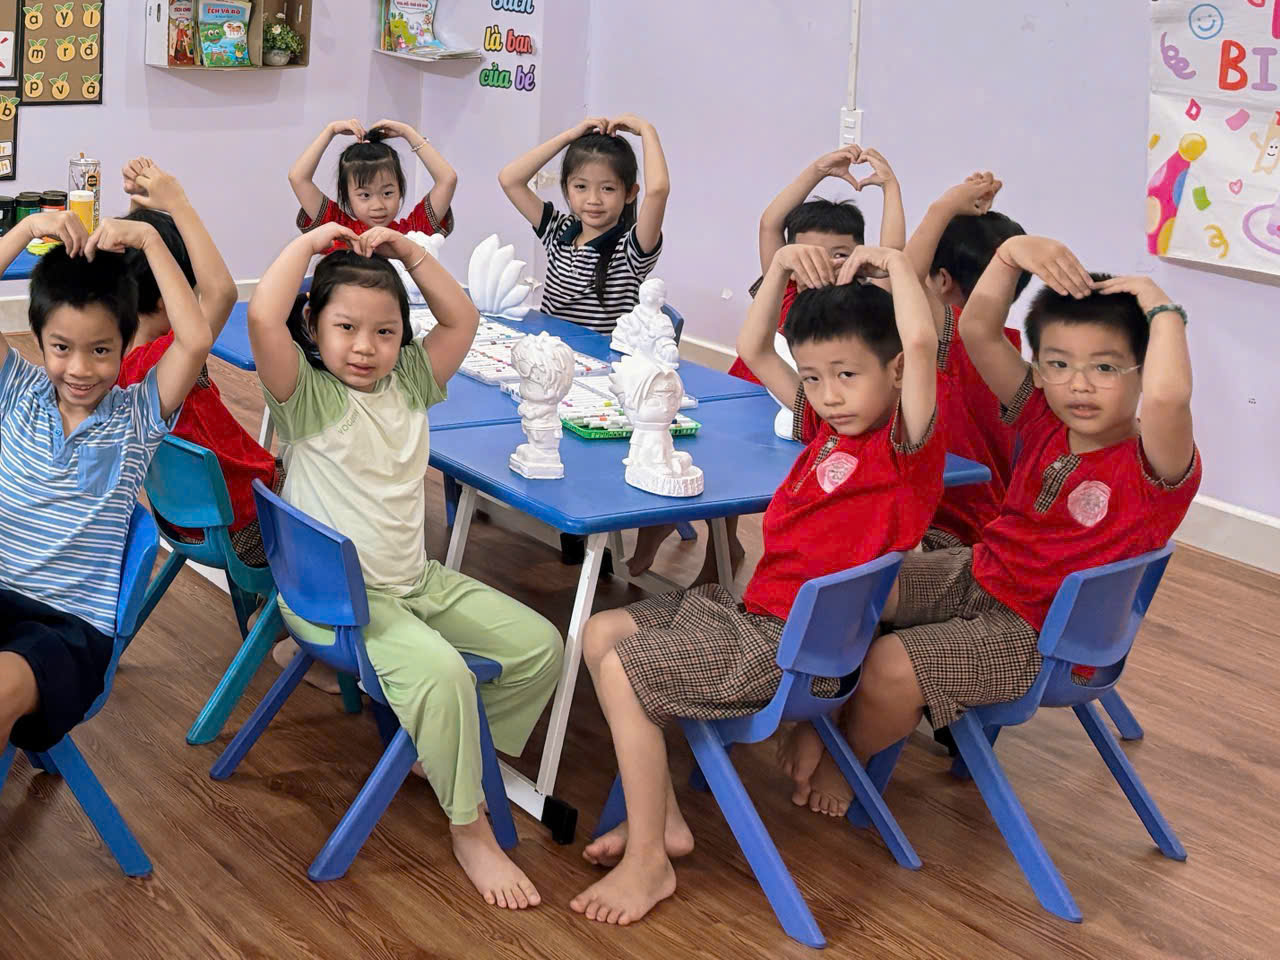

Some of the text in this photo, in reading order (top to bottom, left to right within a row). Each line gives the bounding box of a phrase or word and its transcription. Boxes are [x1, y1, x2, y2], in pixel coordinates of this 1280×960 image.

[29, 15, 38, 24] a
[60, 11, 69, 25] y
[483, 24, 533, 56] là bạn
[31, 43, 93, 59] m r đ
[479, 62, 536, 92] của bé
[29, 81, 96, 95] p v â
[2, 103, 12, 117] b
